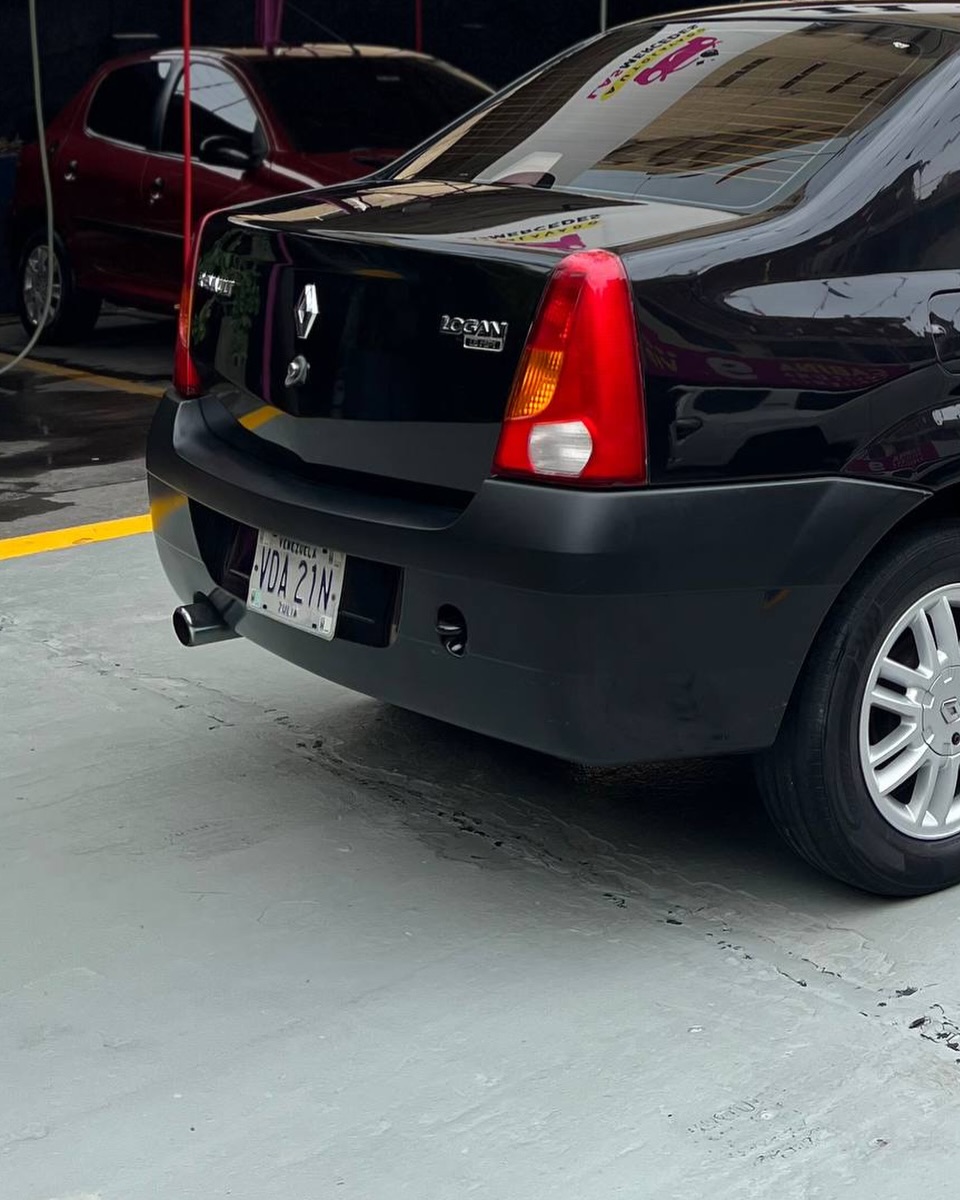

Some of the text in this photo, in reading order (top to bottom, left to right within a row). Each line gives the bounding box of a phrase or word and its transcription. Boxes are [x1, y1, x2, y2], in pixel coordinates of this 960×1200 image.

[440, 314, 509, 339] LOGAN
[259, 546, 333, 611] VDA 21N
